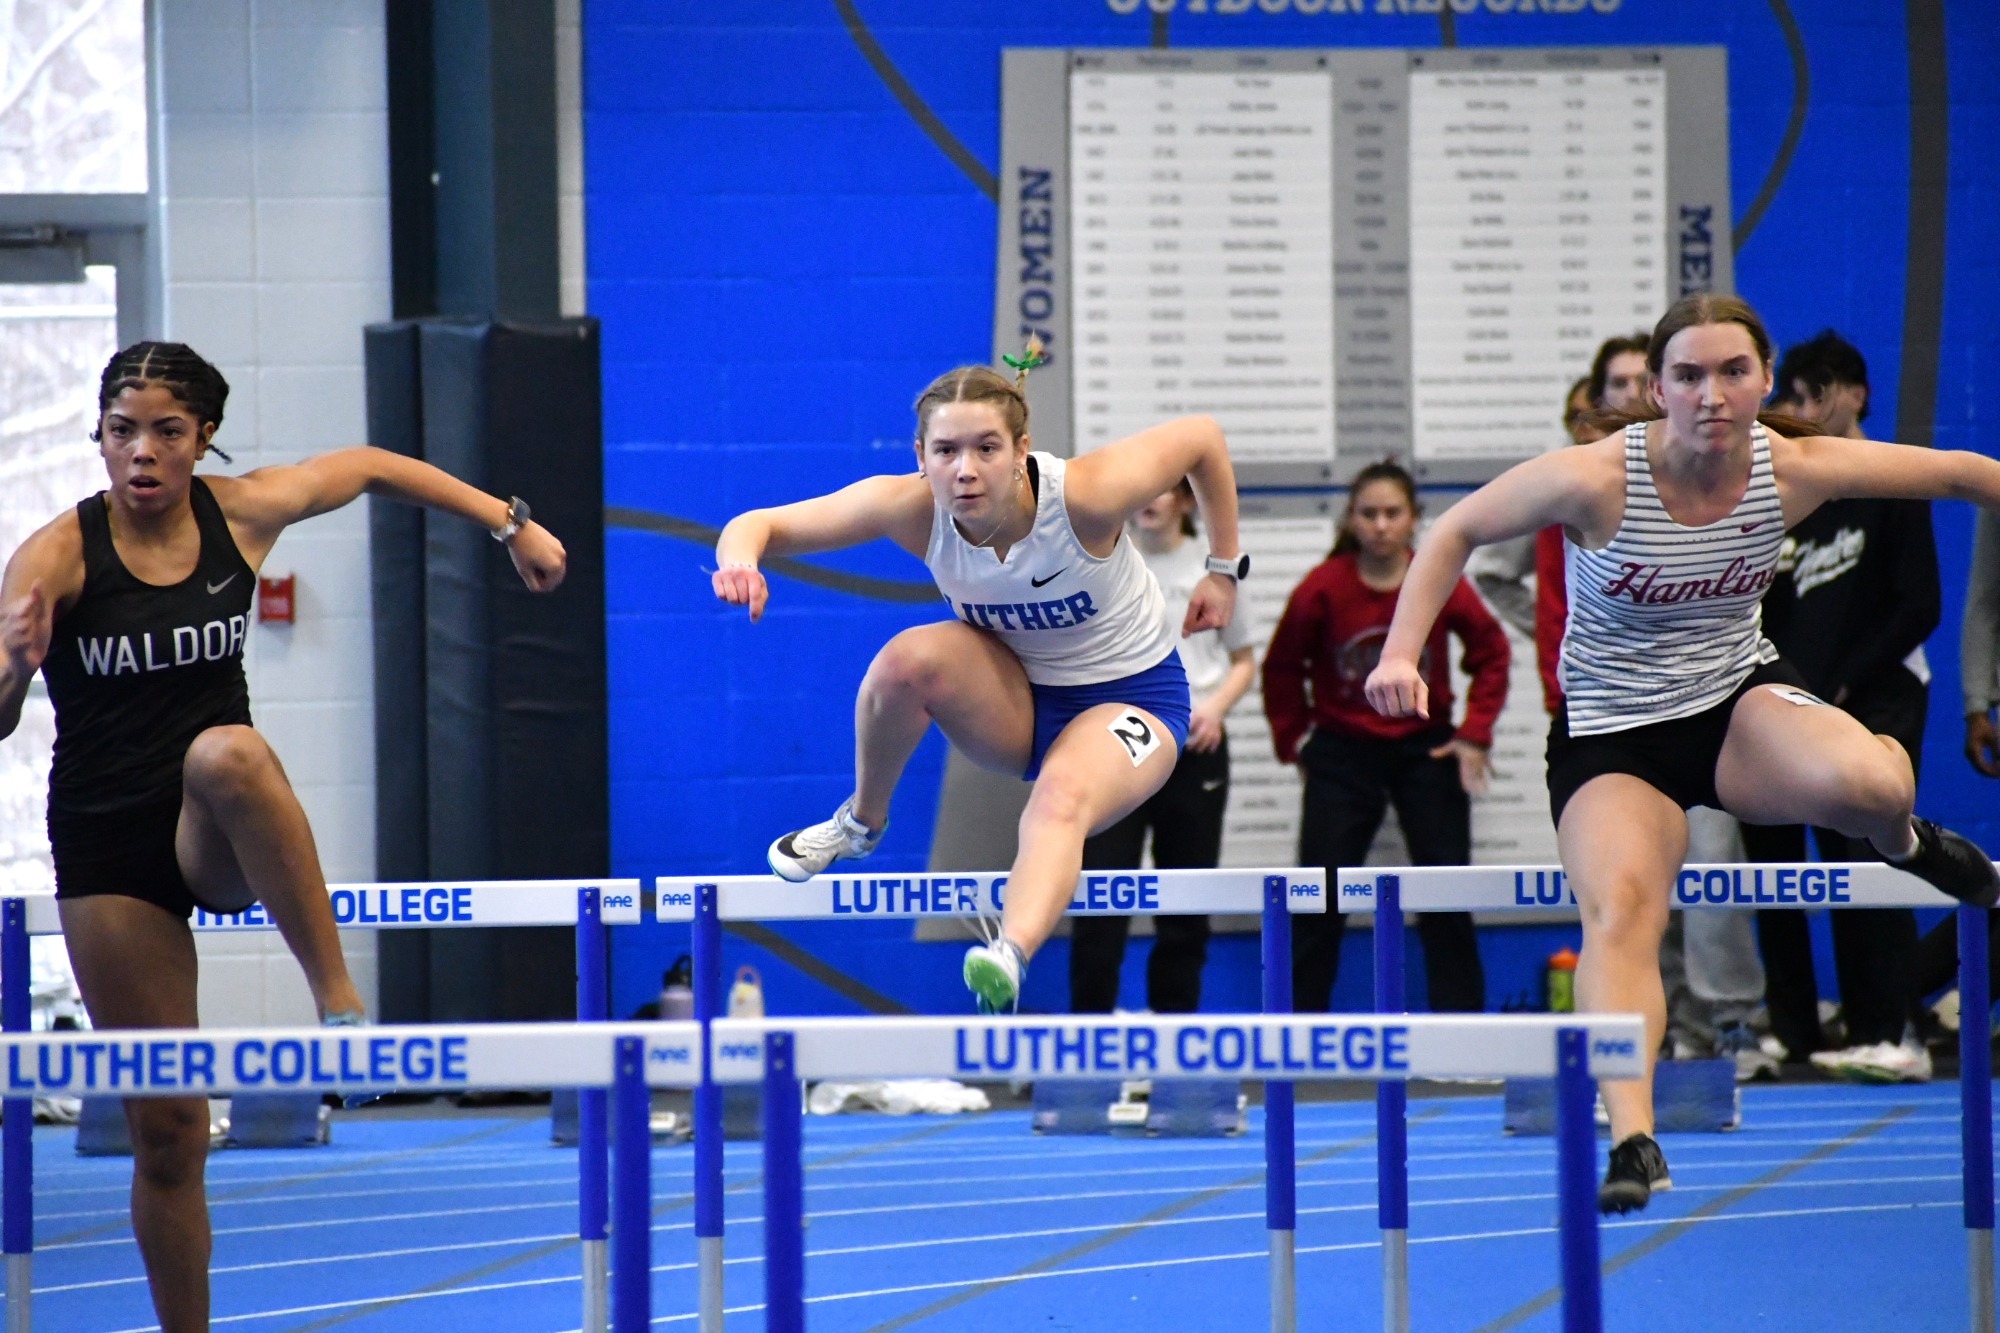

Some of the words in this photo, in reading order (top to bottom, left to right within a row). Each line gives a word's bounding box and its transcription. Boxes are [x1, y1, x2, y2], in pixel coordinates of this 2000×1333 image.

[944, 590, 1099, 631] UTHER
[1113, 716, 1152, 758] 2
[329, 888, 473, 924] OLLEGE
[832, 878, 978, 914] LUTHER
[1677, 869, 1850, 904] COLLEGE
[8, 1041, 215, 1090] LUTHER
[232, 1036, 469, 1085] COLLEGE
[955, 1026, 1158, 1073] LUTHER
[1175, 1025, 1410, 1072] COLLEGE
